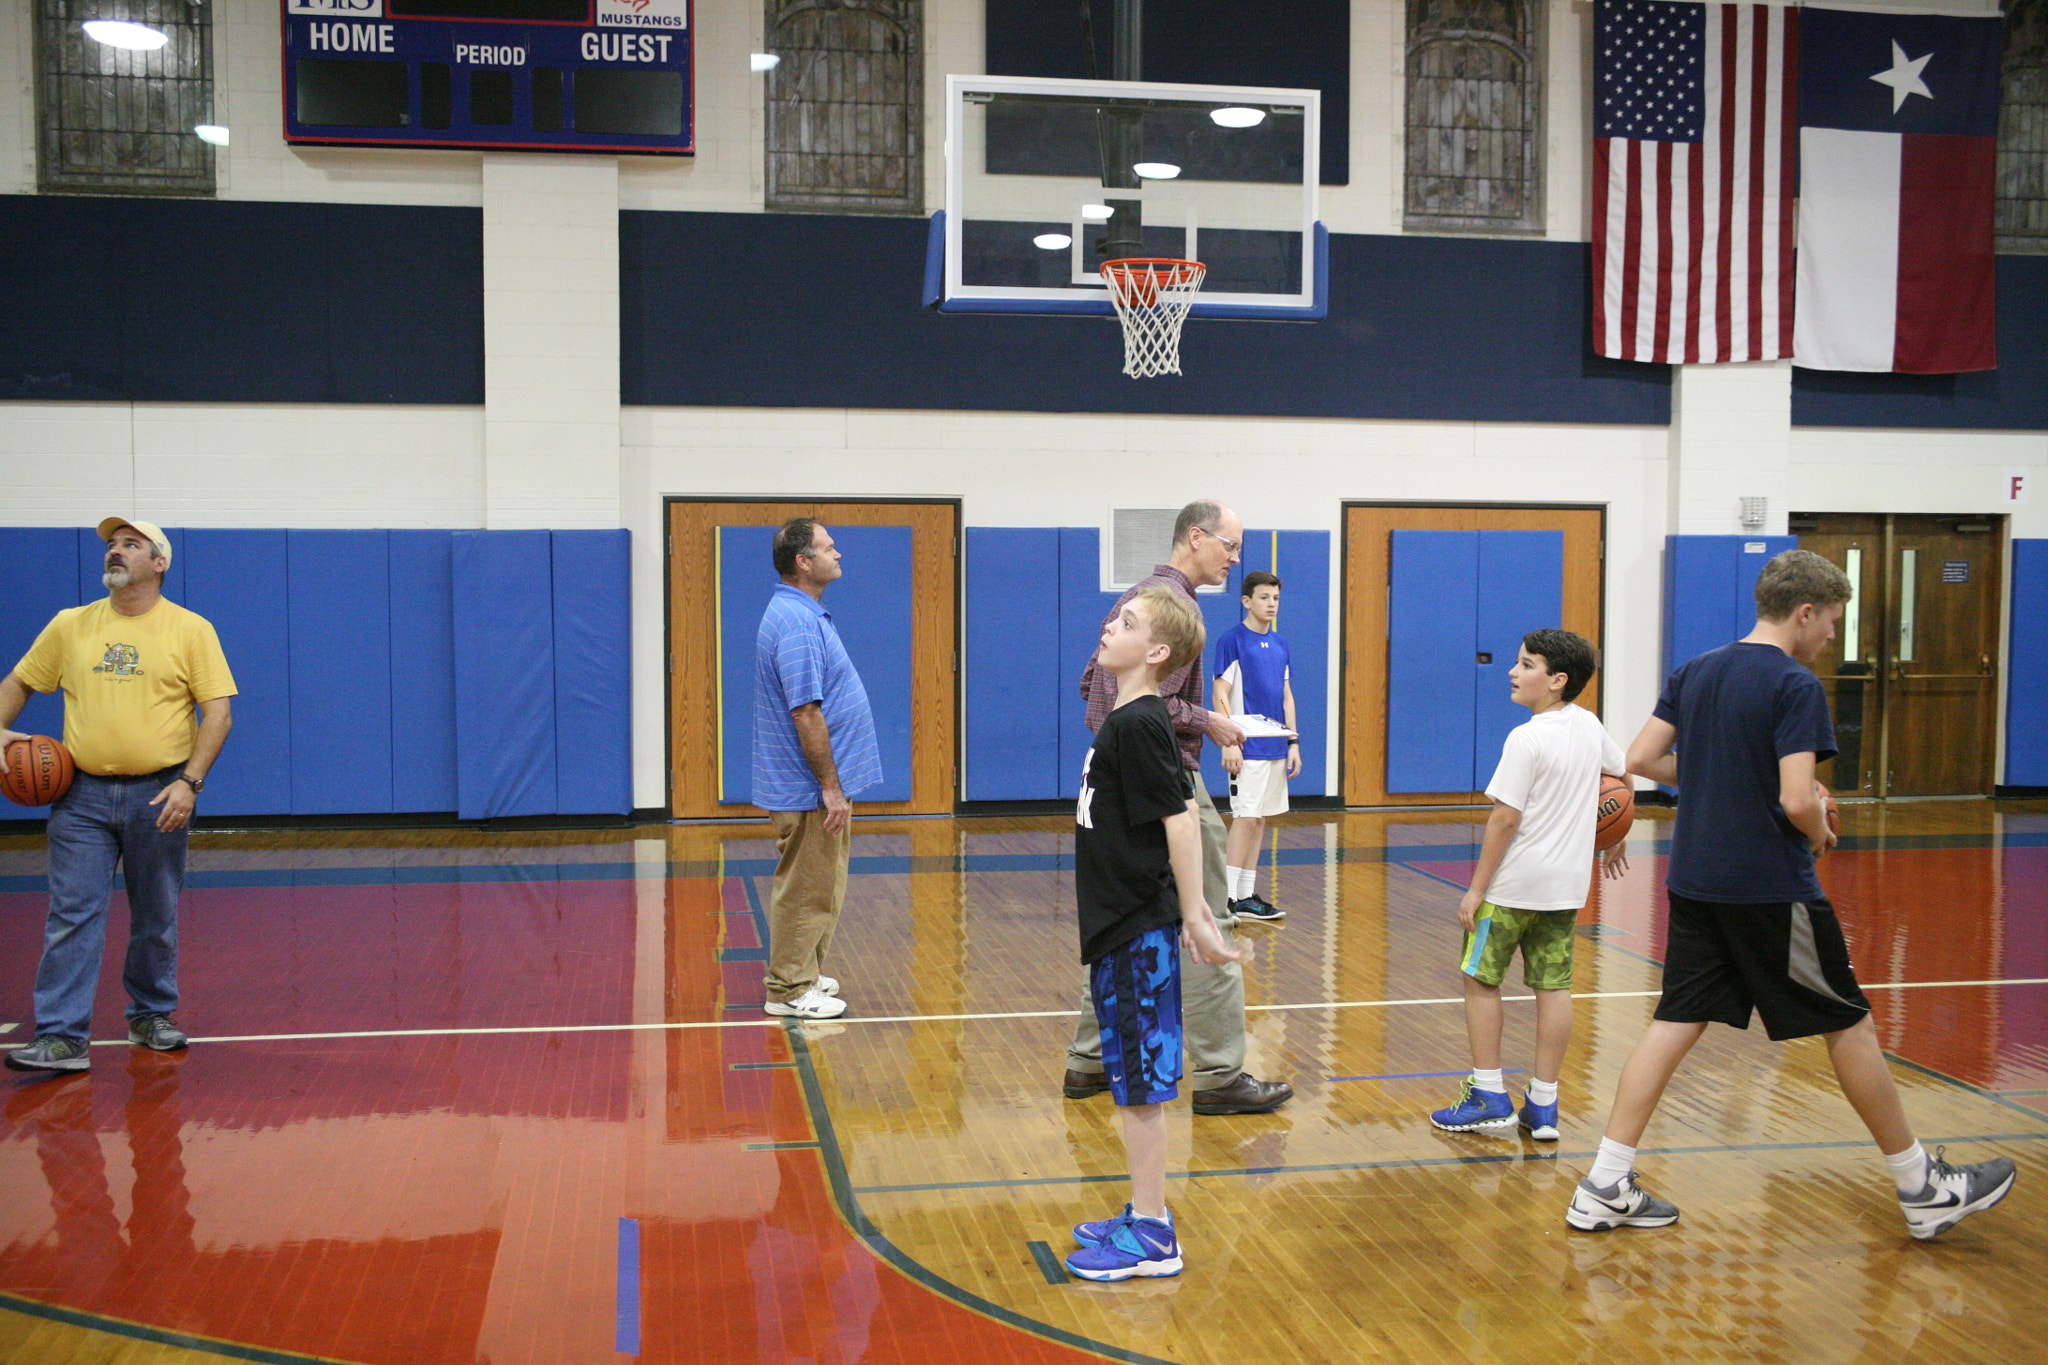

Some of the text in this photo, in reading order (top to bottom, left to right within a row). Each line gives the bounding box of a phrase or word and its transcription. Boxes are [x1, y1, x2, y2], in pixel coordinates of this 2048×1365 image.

[601, 13, 682, 27] MUSTANGS
[310, 22, 395, 53] HOME
[581, 32, 673, 63] GUEST
[456, 44, 526, 66] PERIOD
[2010, 476, 2024, 500] F
[37, 743, 54, 791] Wilson
